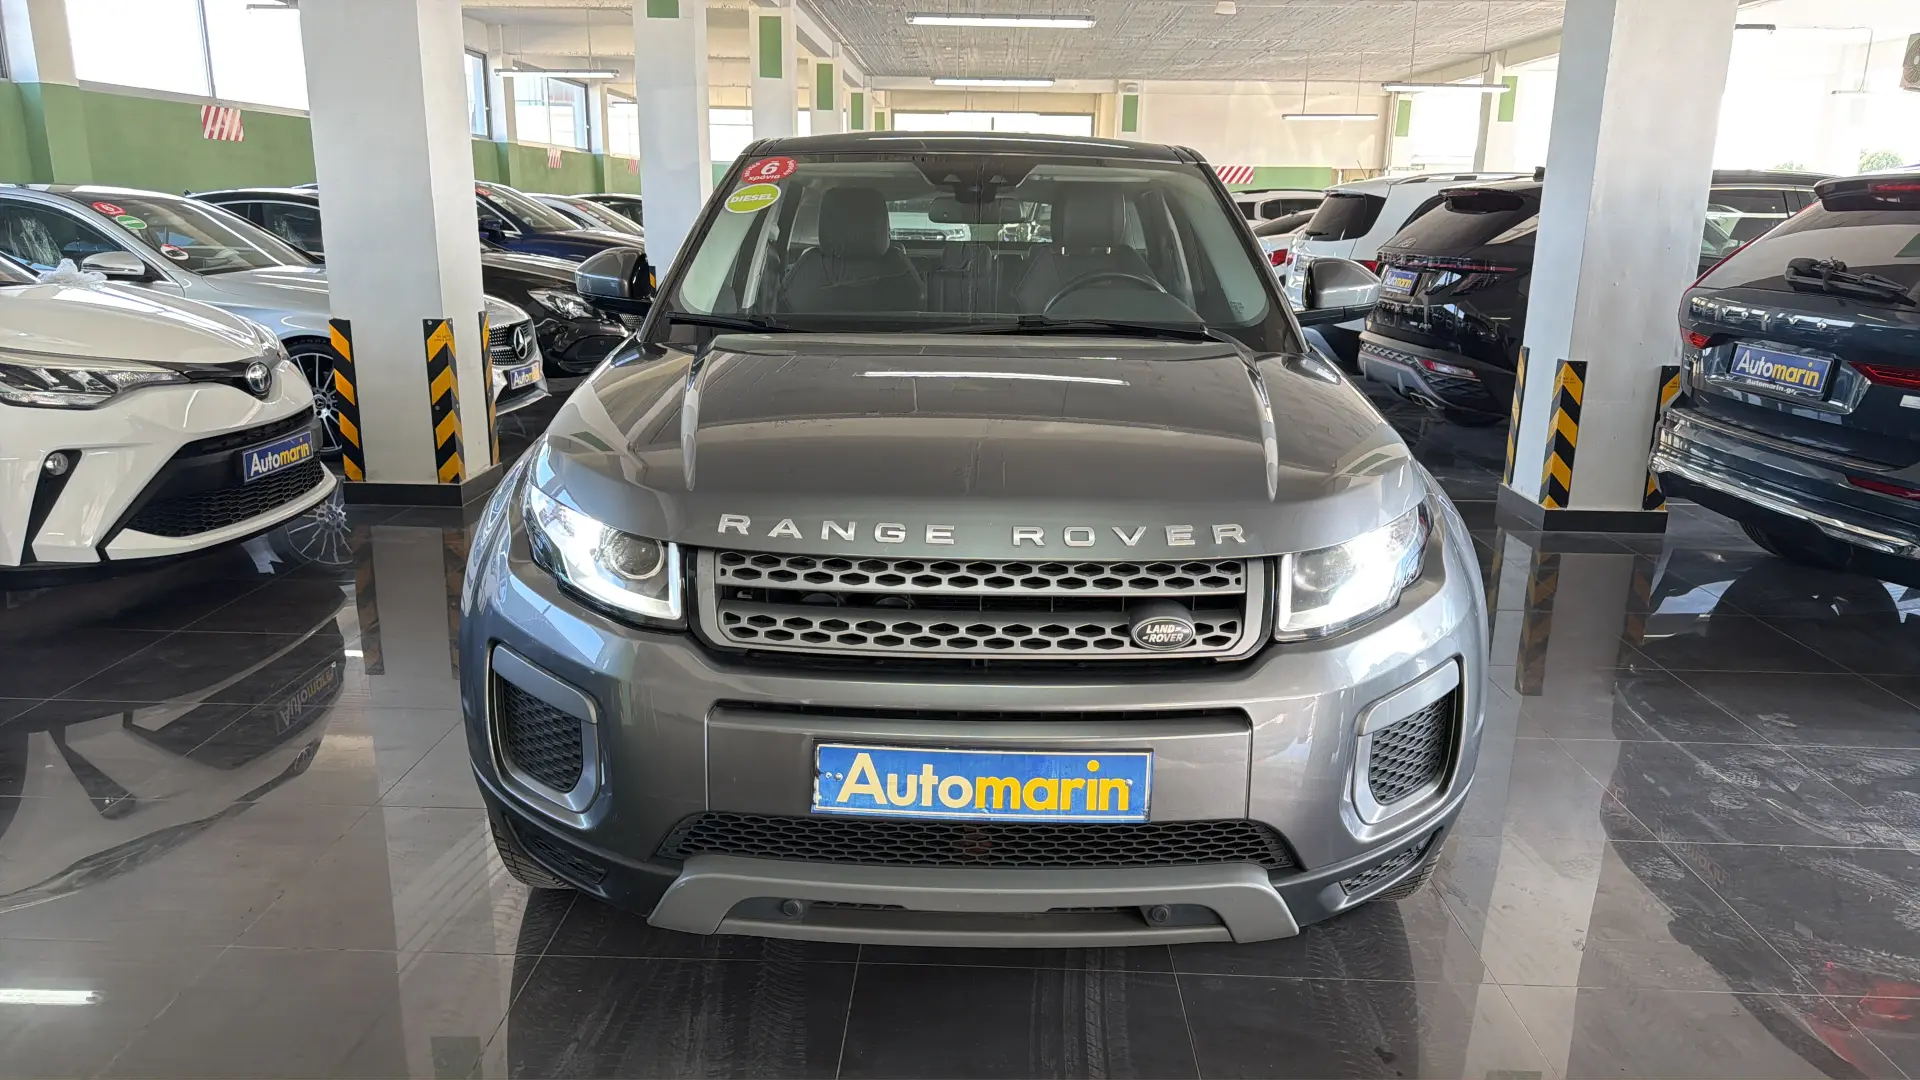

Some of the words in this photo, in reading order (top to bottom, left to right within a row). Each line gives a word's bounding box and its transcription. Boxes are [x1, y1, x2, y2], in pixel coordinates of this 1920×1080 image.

[761, 162, 780, 175] 6
[730, 194, 774, 203] DIESEL
[1736, 350, 1820, 388] Automarin
[1746, 379, 1796, 395] Automarin.gr
[251, 437, 309, 477] Automarin
[717, 513, 955, 545] RANGE
[1012, 523, 1246, 547] ROVER
[1146, 624, 1175, 634] LAND
[1148, 633, 1184, 643] ROVER
[836, 752, 1131, 812] Automarin
